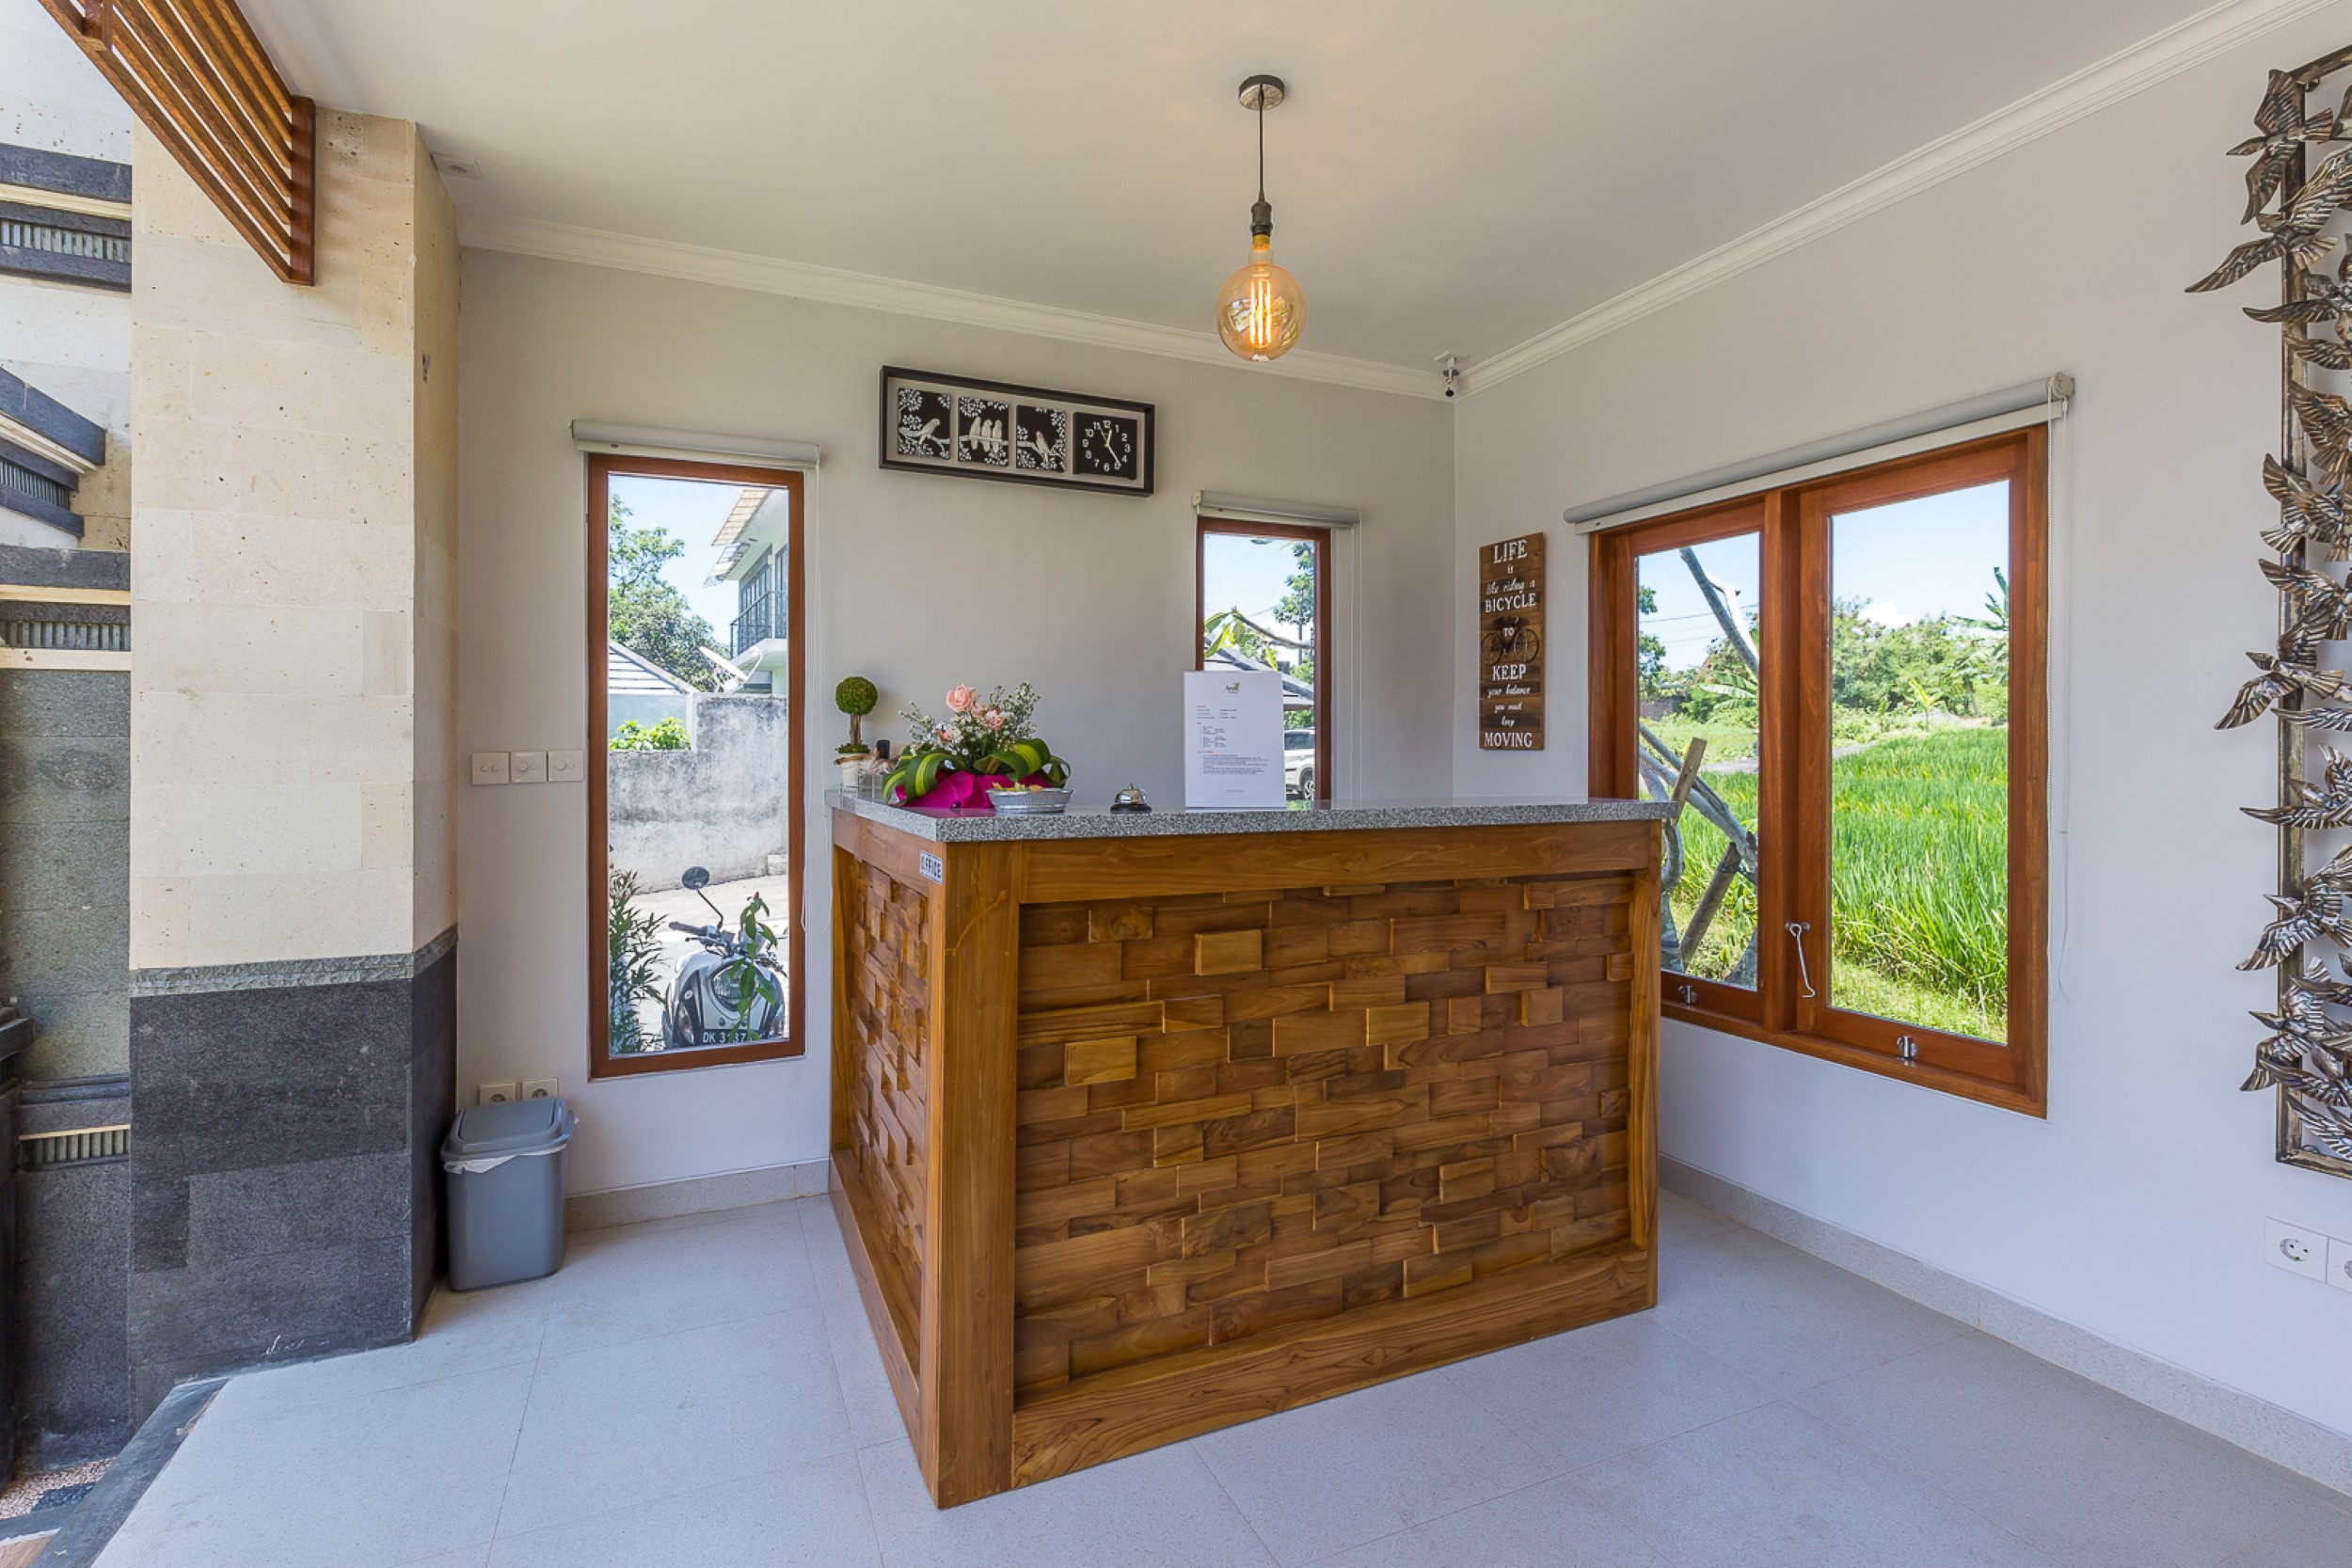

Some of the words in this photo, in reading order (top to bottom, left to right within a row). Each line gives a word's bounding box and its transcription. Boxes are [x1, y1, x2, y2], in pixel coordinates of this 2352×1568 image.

[1103, 420, 1111, 428] 12
[1085, 429, 1094, 437] 10
[1122, 433, 1128, 442] 2
[1082, 439, 1089, 447] 9
[1124, 444, 1131, 453] 3
[1085, 450, 1092, 458] 8
[1094, 458, 1099, 467] 7
[1104, 462, 1110, 472] 6
[1493, 539, 1528, 563] LIFE
[1507, 563, 1515, 574] is
[1486, 581, 1499, 595] like
[1503, 578, 1525, 594] riding
[1529, 579, 1535, 588] a
[1485, 593, 1536, 612] BICYCLE
[1503, 627, 1515, 636] TO
[1492, 663, 1527, 681] KEEP
[1487, 688, 1502, 698] your
[1506, 684, 1531, 695] balance
[1494, 705, 1505, 714] you
[1508, 701, 1523, 710] must
[1501, 716, 1515, 728] keep
[1484, 732, 1533, 748] MOVING
[921, 856, 941, 879] OFFICE
[703, 1031, 716, 1043] DK
